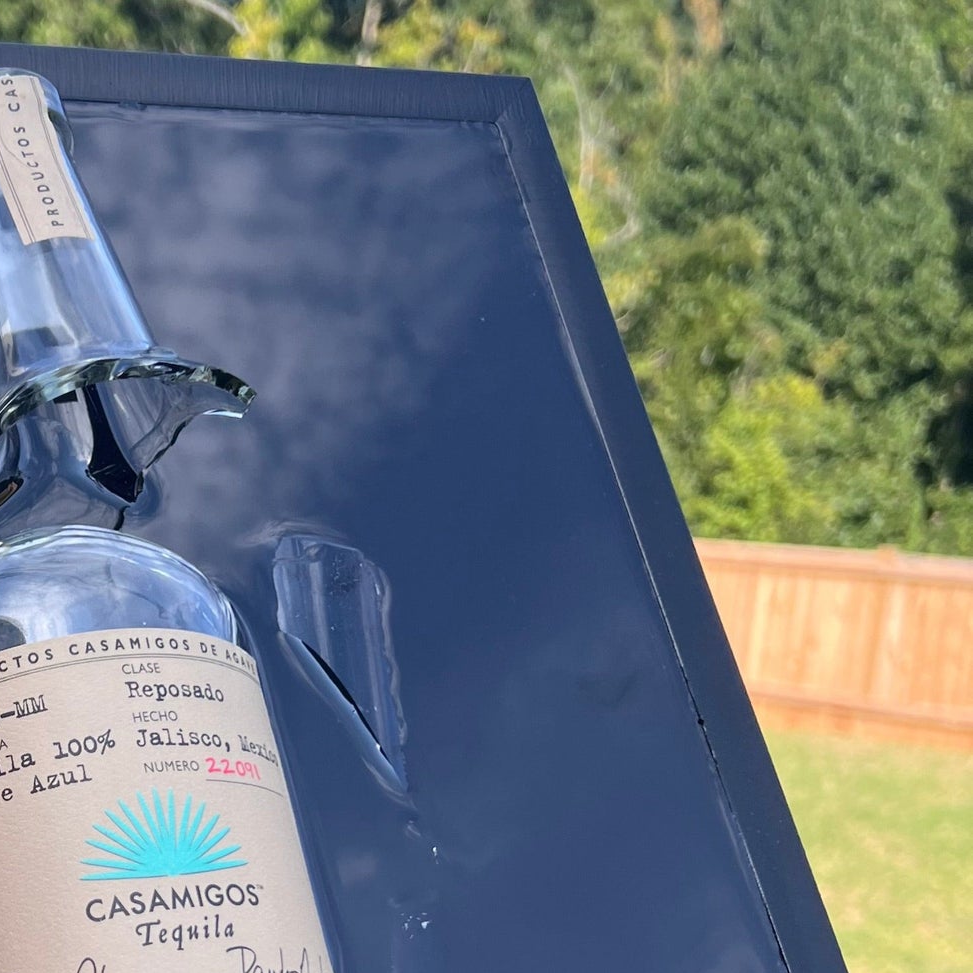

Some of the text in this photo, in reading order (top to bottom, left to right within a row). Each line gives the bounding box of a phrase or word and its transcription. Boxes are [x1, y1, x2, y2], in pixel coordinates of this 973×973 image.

[13, 126, 64, 227] PRODUCTOS
[69, 637, 190, 655] CASAMIGOS
[200, 642, 217, 656] DE
[121, 662, 161, 675] CLASE
[125, 680, 225, 702] Reposado
[132, 710, 178, 724] HECHO
[54, 729, 116, 760] 100%
[136, 728, 231, 752] Jalisco,
[30, 764, 93, 795] Azul
[143, 756, 261, 781] NUMERO 22091
[85, 883, 260, 923] CASAMIGOS
[135, 914, 235, 950] Tequila
